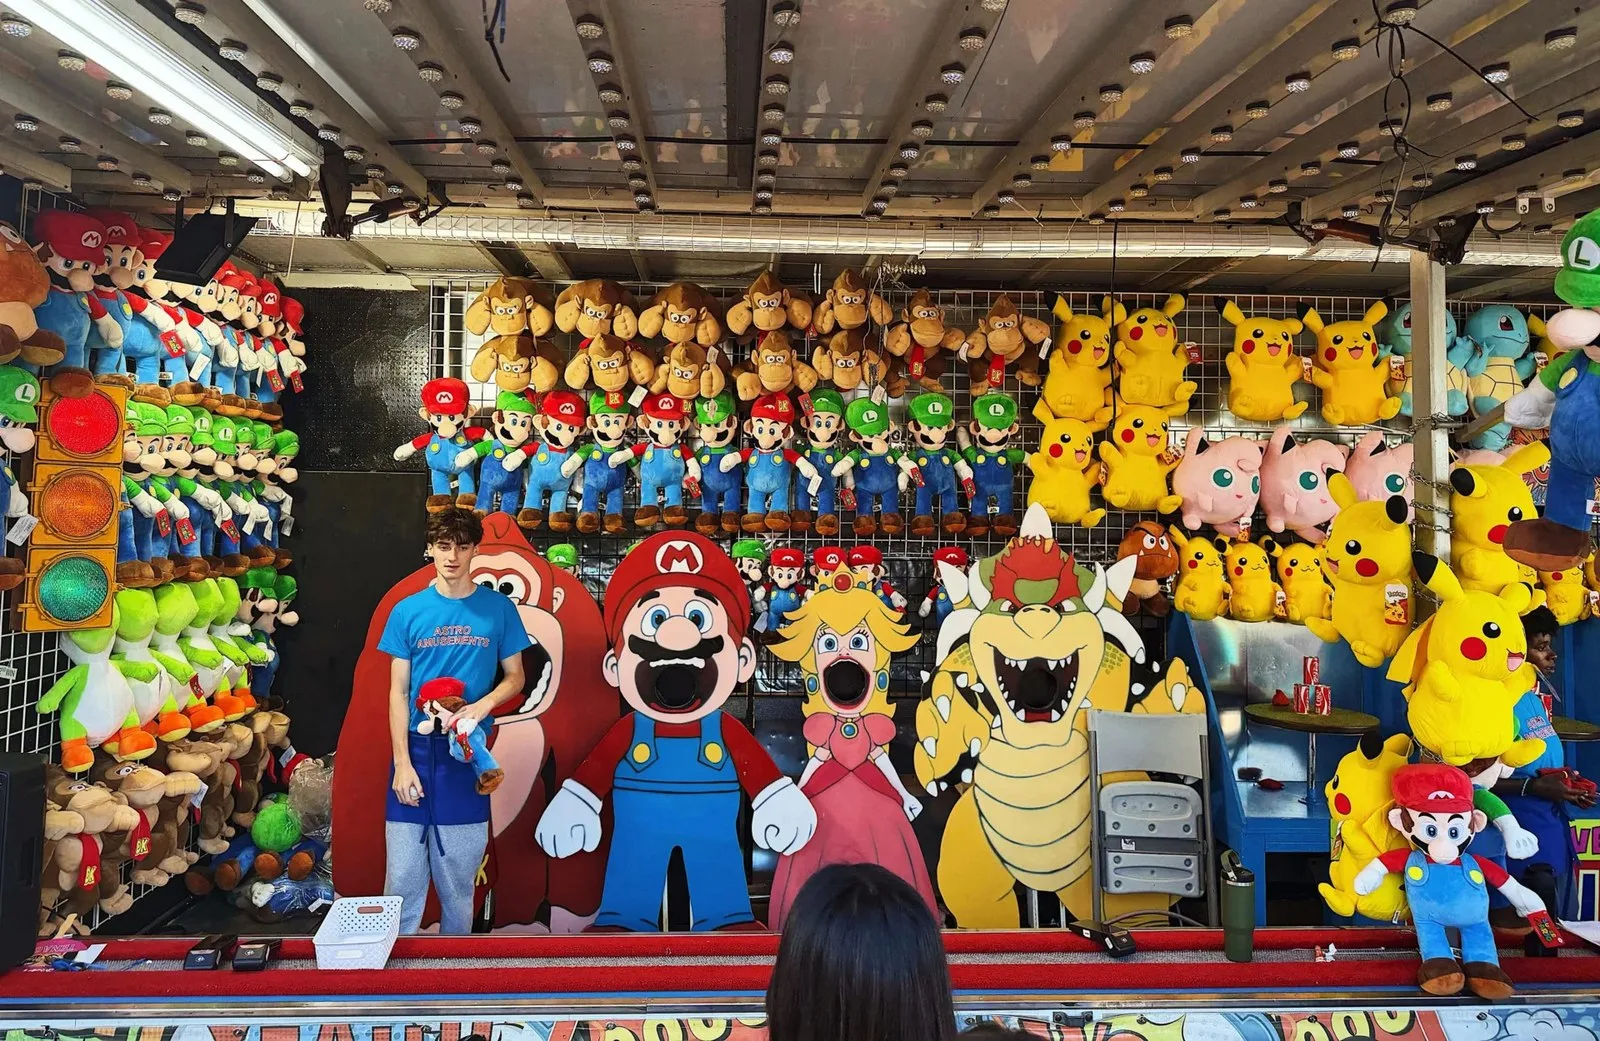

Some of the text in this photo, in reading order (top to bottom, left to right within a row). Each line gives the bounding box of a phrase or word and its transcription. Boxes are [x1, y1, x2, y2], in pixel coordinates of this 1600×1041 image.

[83, 233, 99, 245] M
[1574, 240, 1590, 266] L
[21, 385, 31, 401] L
[438, 393, 451, 401] M
[660, 544, 699, 571] M
[433, 625, 472, 636] ASTRO
[417, 635, 490, 648] AMUSEMENTS
